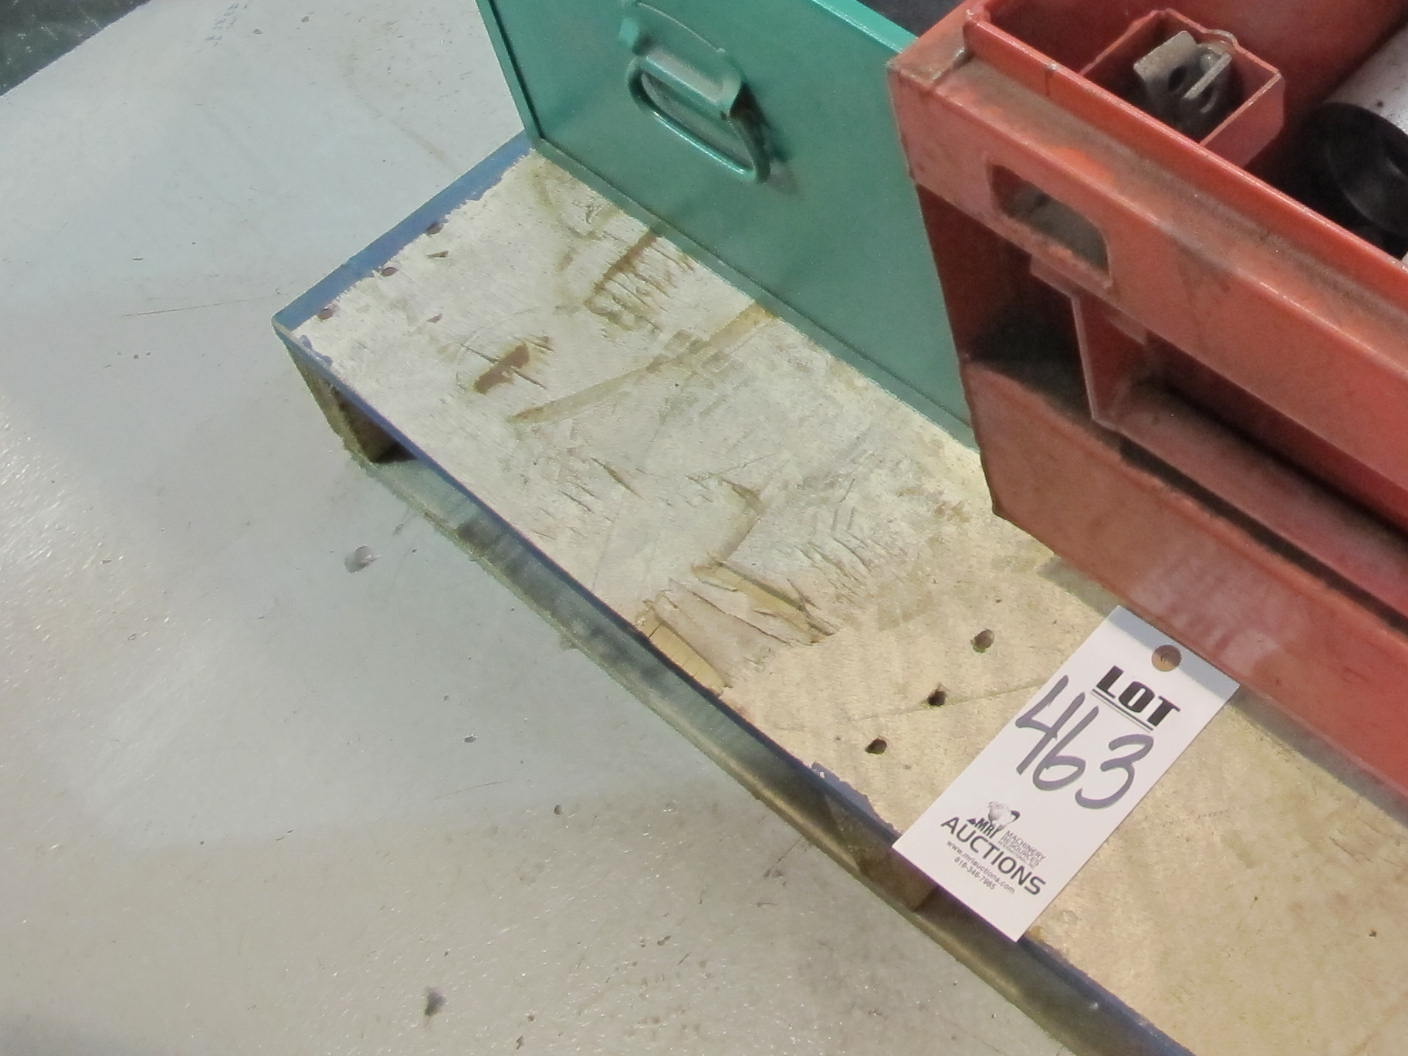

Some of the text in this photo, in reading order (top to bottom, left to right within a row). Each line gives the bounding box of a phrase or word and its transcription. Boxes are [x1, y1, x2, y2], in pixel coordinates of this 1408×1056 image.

[1095, 664, 1180, 728] LOT
[1014, 674, 1154, 810] 463
[940, 816, 1047, 895] AUCTIONS
[975, 817, 1000, 839] MRI
